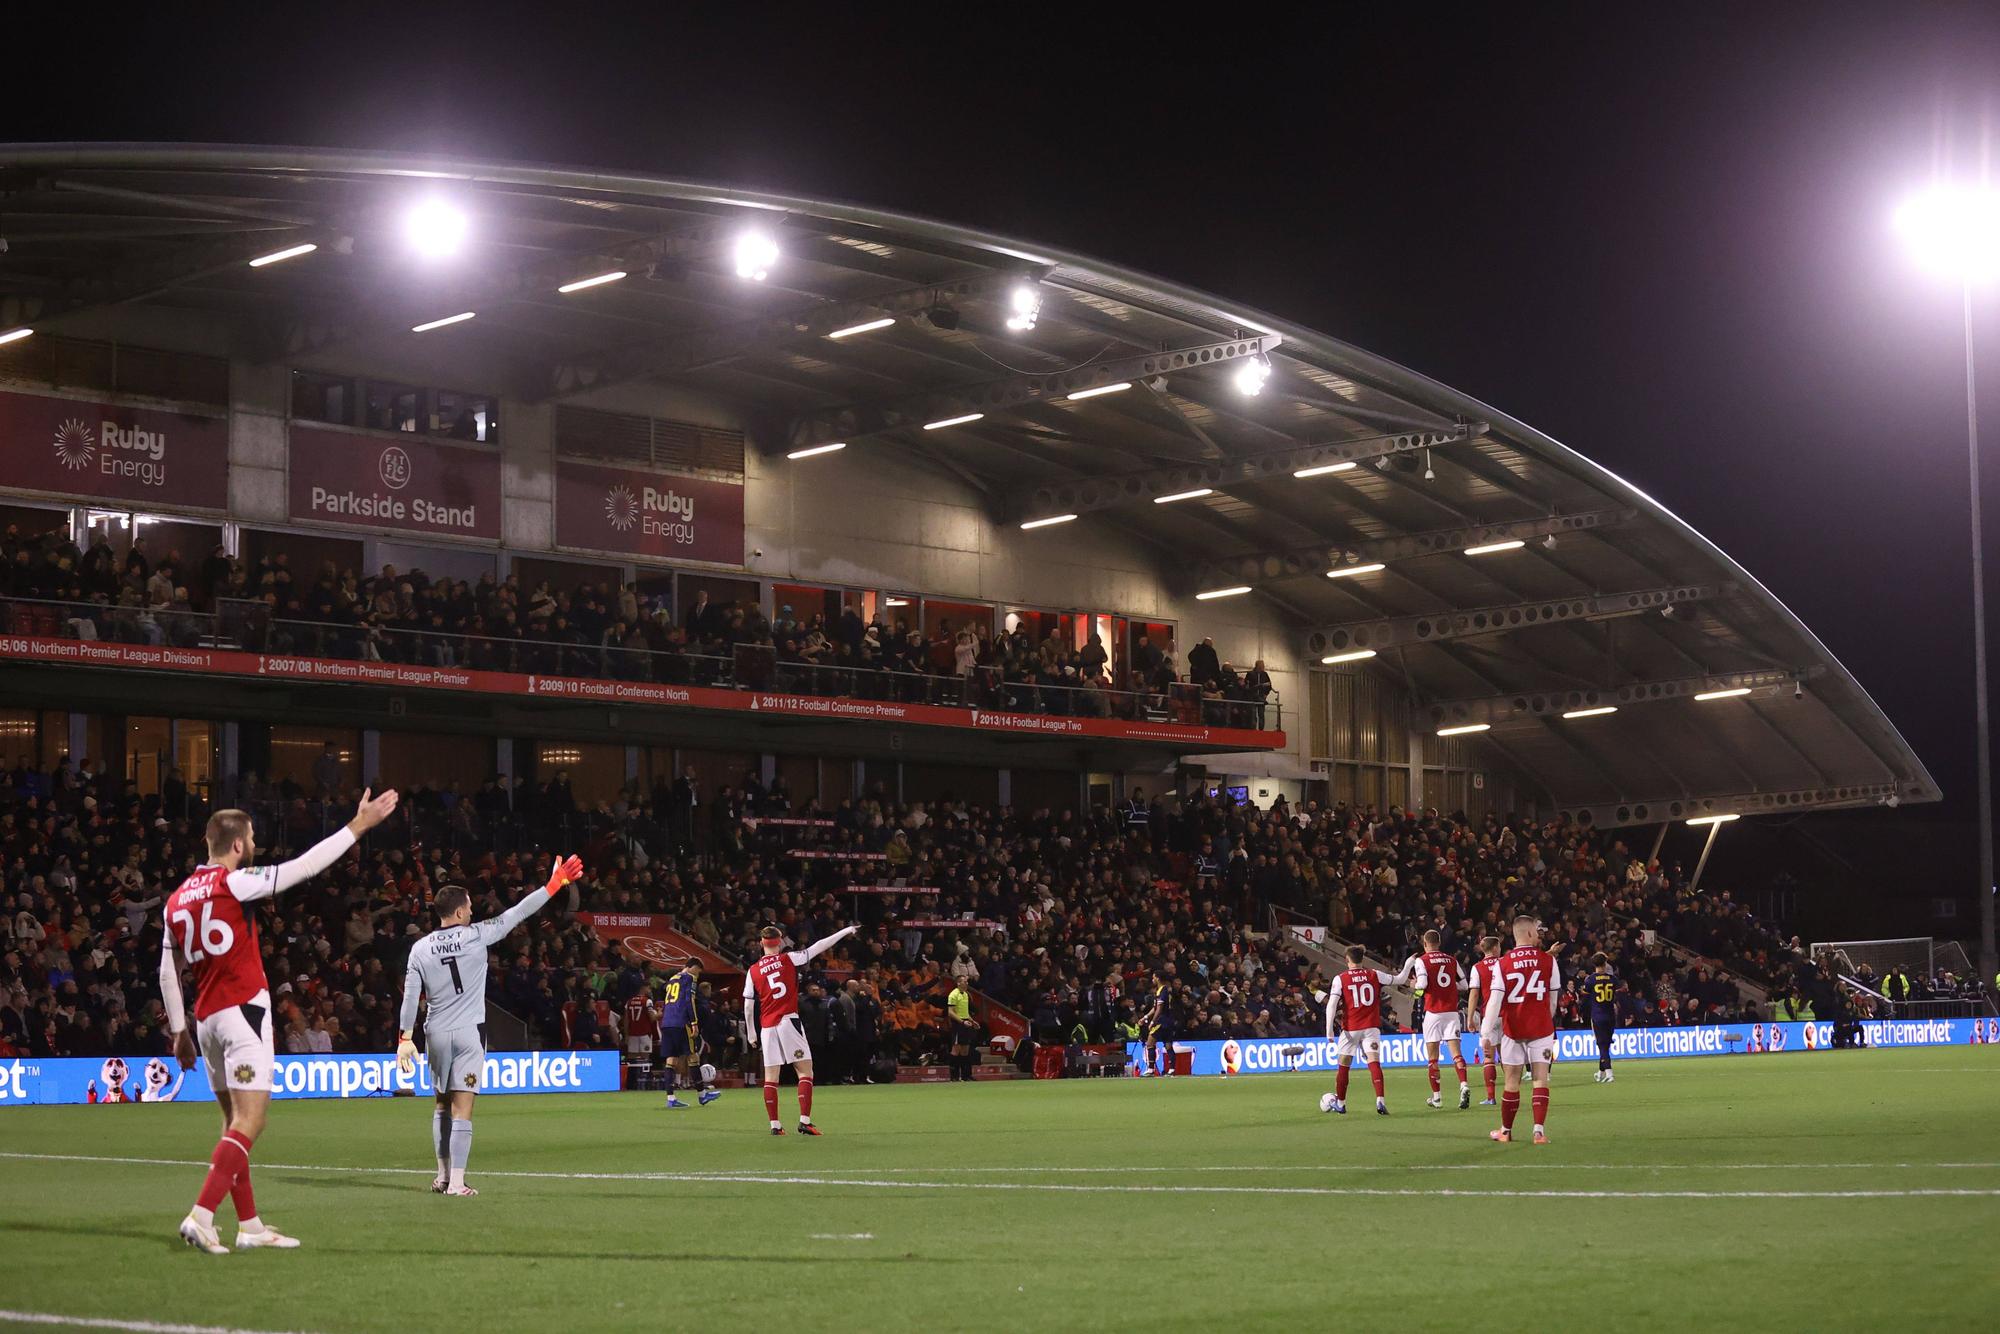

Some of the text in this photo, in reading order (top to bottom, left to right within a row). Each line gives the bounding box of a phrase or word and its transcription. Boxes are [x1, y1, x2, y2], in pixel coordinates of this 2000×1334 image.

[101, 421, 165, 460] Ruby
[101, 454, 165, 486] Energy
[312, 487, 475, 527] Parkside Stand
[643, 487, 694, 521] Ruby
[643, 516, 694, 544] Energy
[0, 639, 211, 666] 5/06 Northern Premier League Division 1
[269, 659, 469, 685] 2007/08 Northern Premier League Premier
[540, 679, 689, 700] 2009/10 Football Conference North
[762, 696, 905, 716] 2011/12 Football Conference Premier
[980, 714, 1082, 731] 2013/14 Football League Two
[178, 884, 214, 906] ROONEY
[172, 901, 234, 964] 26
[594, 915, 652, 927] THIS IS HIGHBURY
[431, 942, 461, 955] LYNCH
[1510, 950, 1538, 959] BOXT
[440, 956, 464, 995] 1
[760, 961, 783, 976] POTTER
[1437, 965, 1451, 988] 6
[1513, 960, 1539, 970] BATTY
[664, 982, 680, 1005] 29
[766, 971, 787, 1000] 5
[1347, 983, 1375, 1008] 10
[1506, 970, 1546, 1004] 24
[1594, 983, 1614, 1003] 56
[629, 1006, 643, 1022] 17
[1562, 1025, 1722, 1058] comarethemarket
